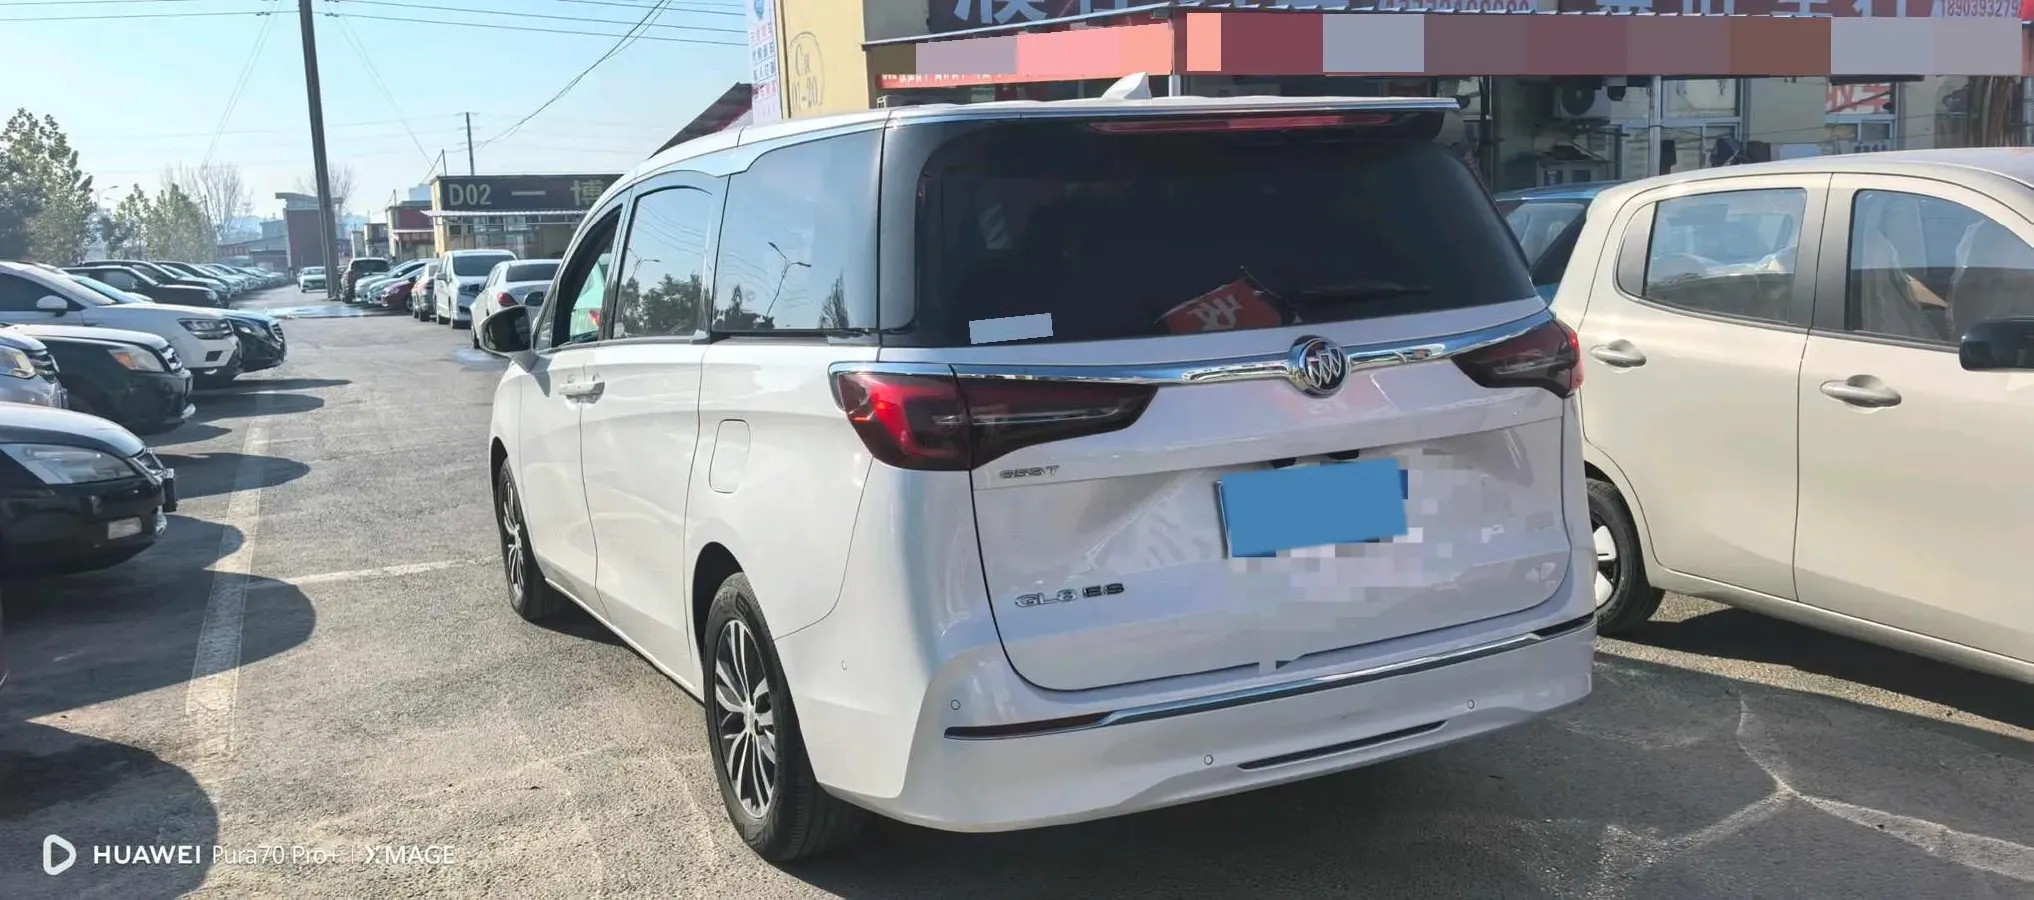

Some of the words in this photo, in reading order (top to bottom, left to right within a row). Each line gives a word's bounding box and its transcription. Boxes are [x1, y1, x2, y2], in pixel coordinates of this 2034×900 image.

[449, 183, 492, 206] D02
[1014, 588, 1078, 608] GL8
[1082, 583, 1125, 599] ES
